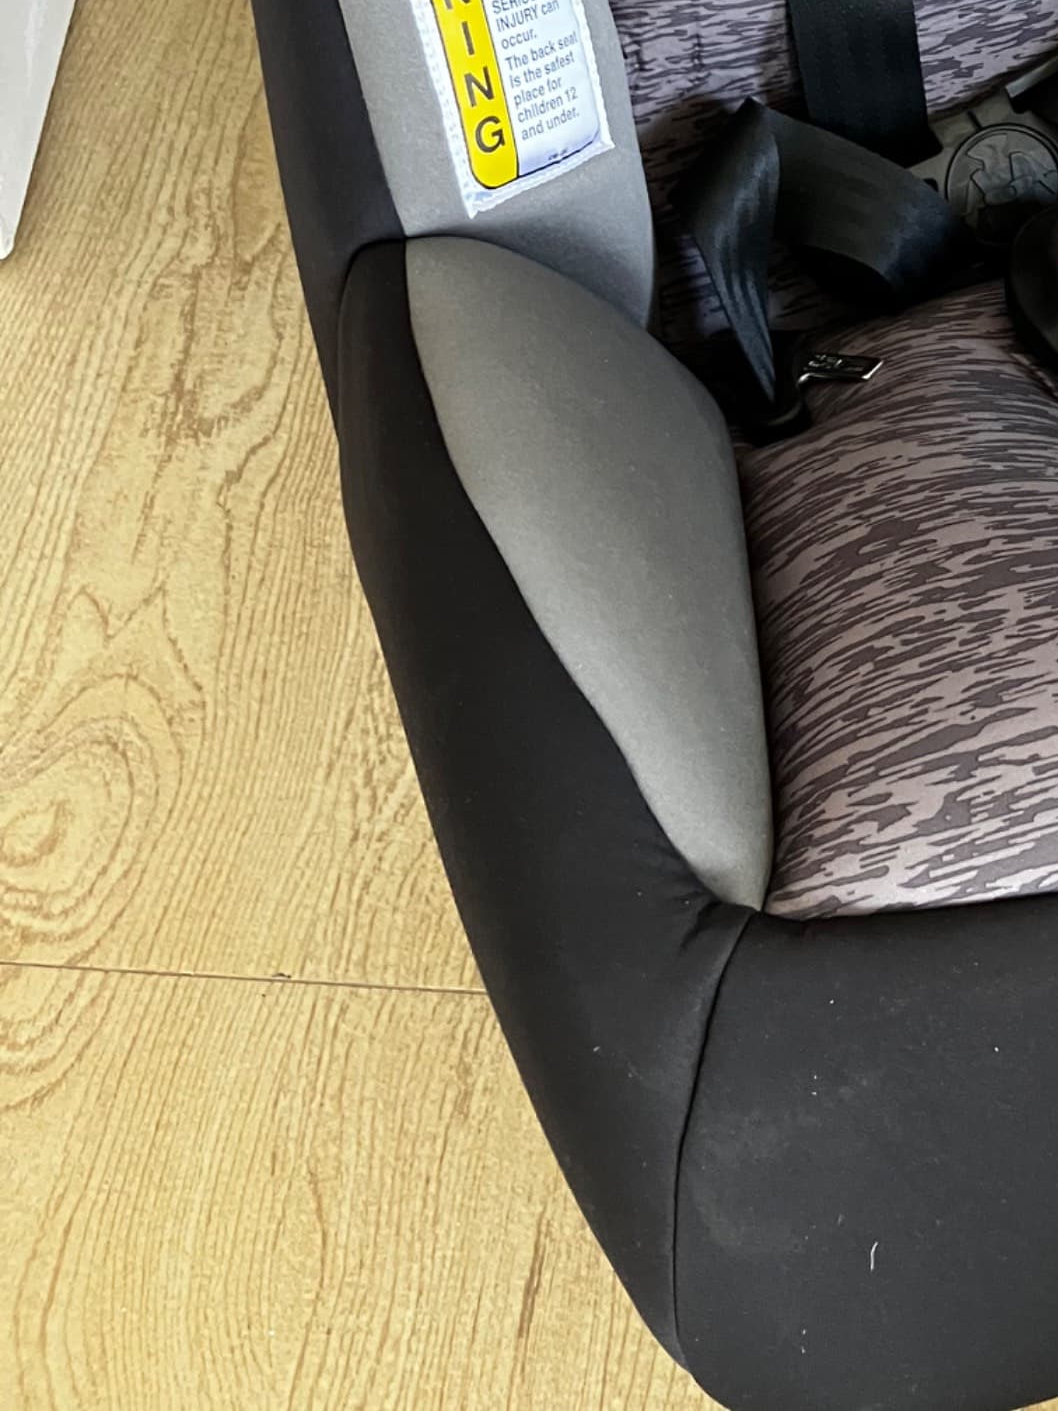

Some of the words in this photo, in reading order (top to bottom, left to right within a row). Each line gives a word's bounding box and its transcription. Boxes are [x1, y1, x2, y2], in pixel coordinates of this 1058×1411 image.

[496, 4, 540, 32] INJURY
[541, 0, 560, 16] can
[501, 29, 538, 50] occur.
[505, 54, 529, 71] The
[532, 40, 556, 61] back
[558, 31, 578, 48] seat
[509, 75, 522, 88] is
[523, 67, 542, 83] the
[545, 51, 575, 75] safest
[514, 85, 545, 109] place
[547, 76, 562, 92] for
[517, 96, 564, 123] children
[565, 86, 579, 103] 12
[521, 124, 545, 141] and
[547, 109, 580, 131] under.
